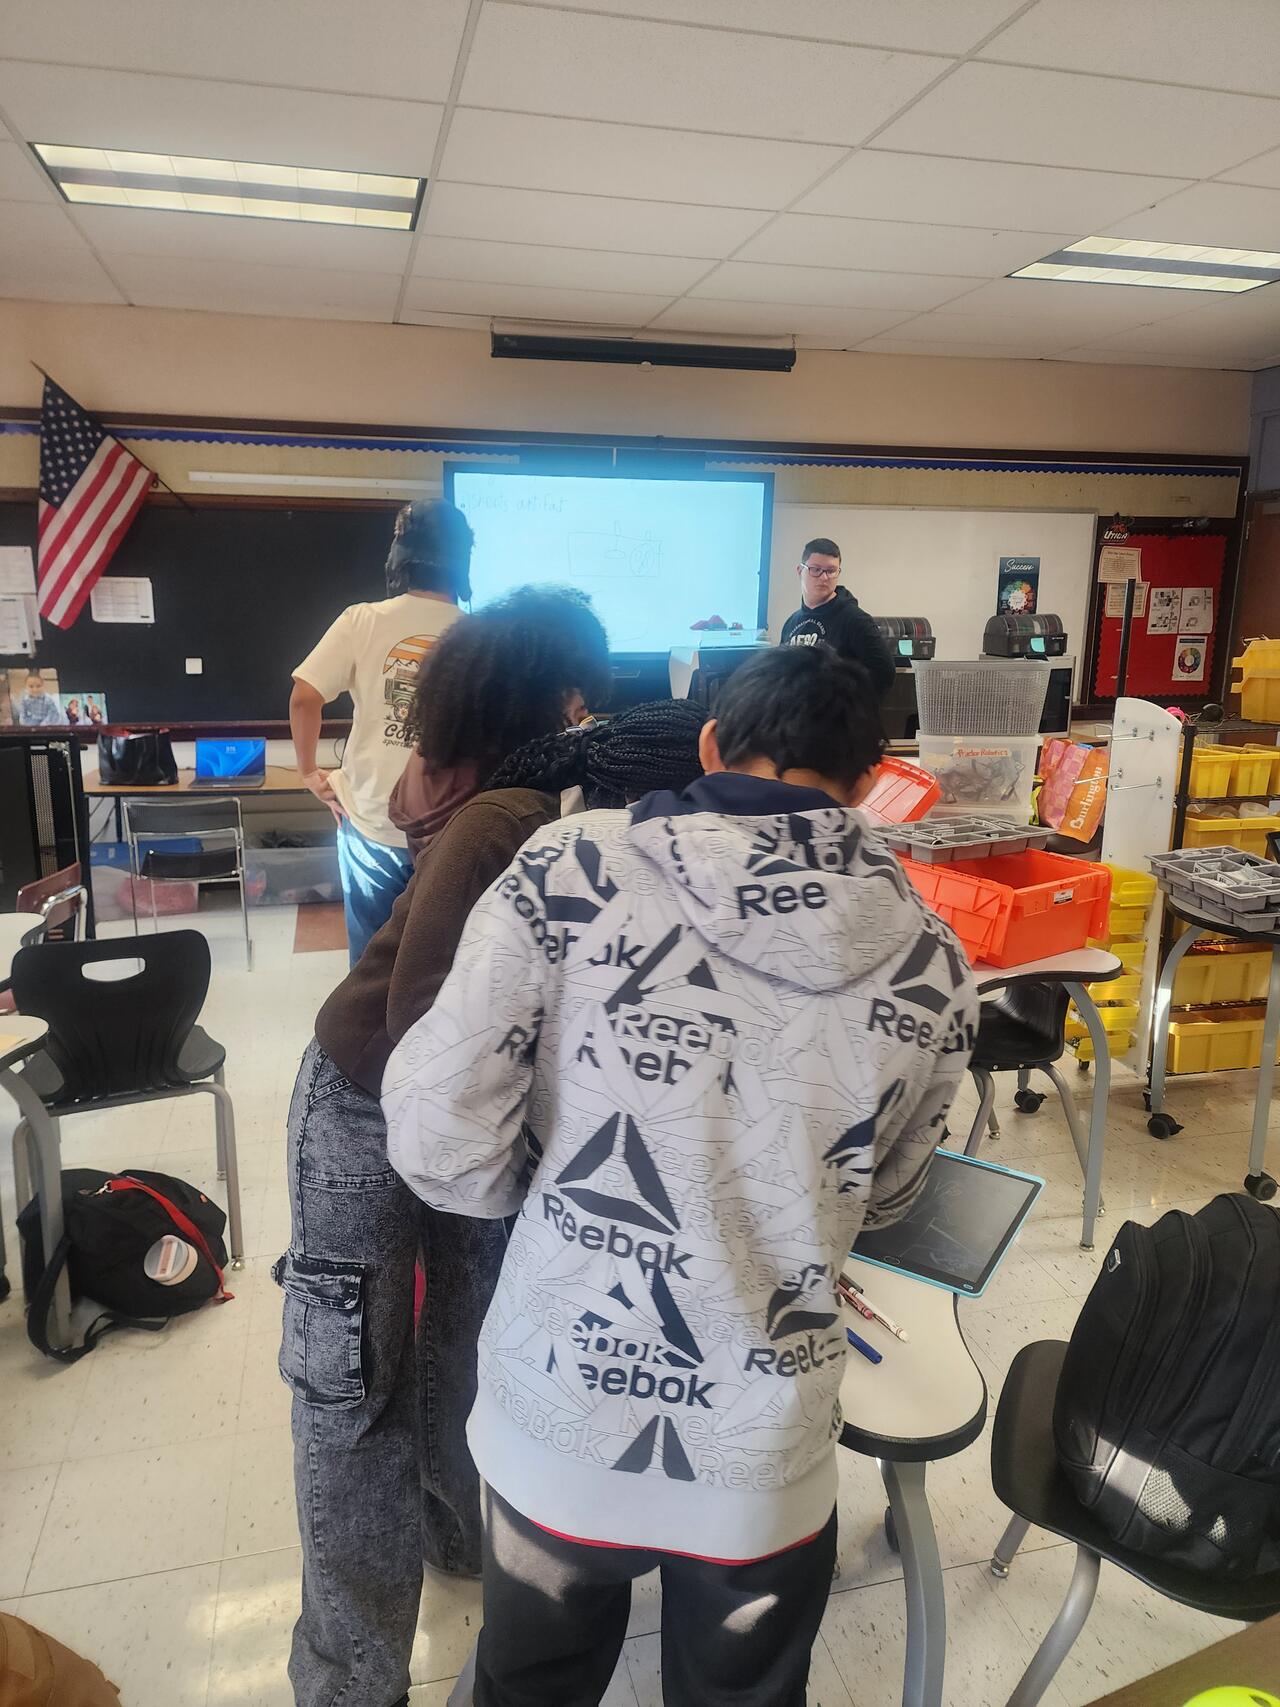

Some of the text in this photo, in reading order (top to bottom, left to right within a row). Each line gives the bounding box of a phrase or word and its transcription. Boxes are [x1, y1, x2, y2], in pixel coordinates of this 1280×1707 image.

[1004, 558, 1034, 573] Success
[1070, 766, 1103, 831] Burlington
[542, 1193, 694, 1280] Reebok
